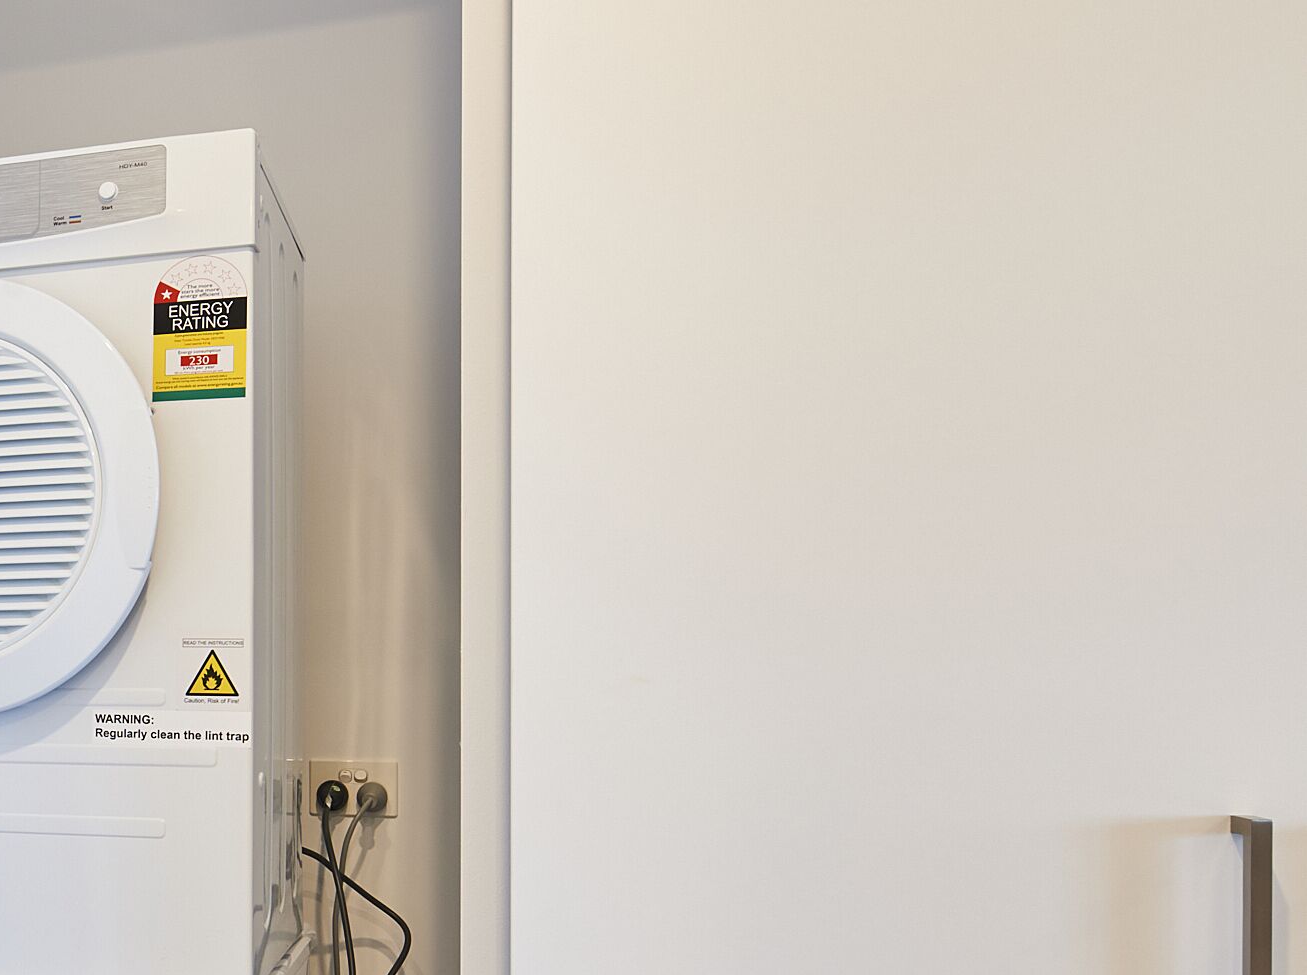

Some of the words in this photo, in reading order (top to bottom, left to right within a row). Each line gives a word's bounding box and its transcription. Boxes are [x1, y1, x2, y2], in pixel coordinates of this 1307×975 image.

[169, 301, 233, 318] ENERGY
[172, 315, 228, 331] RATING
[189, 356, 209, 366] 230
[95, 714, 154, 724] WARNING:
[95, 728, 147, 740] Regularly
[151, 730, 180, 740] clean
[184, 730, 201, 740] the
[205, 731, 223, 740] lint
[226, 732, 249, 743] trap
